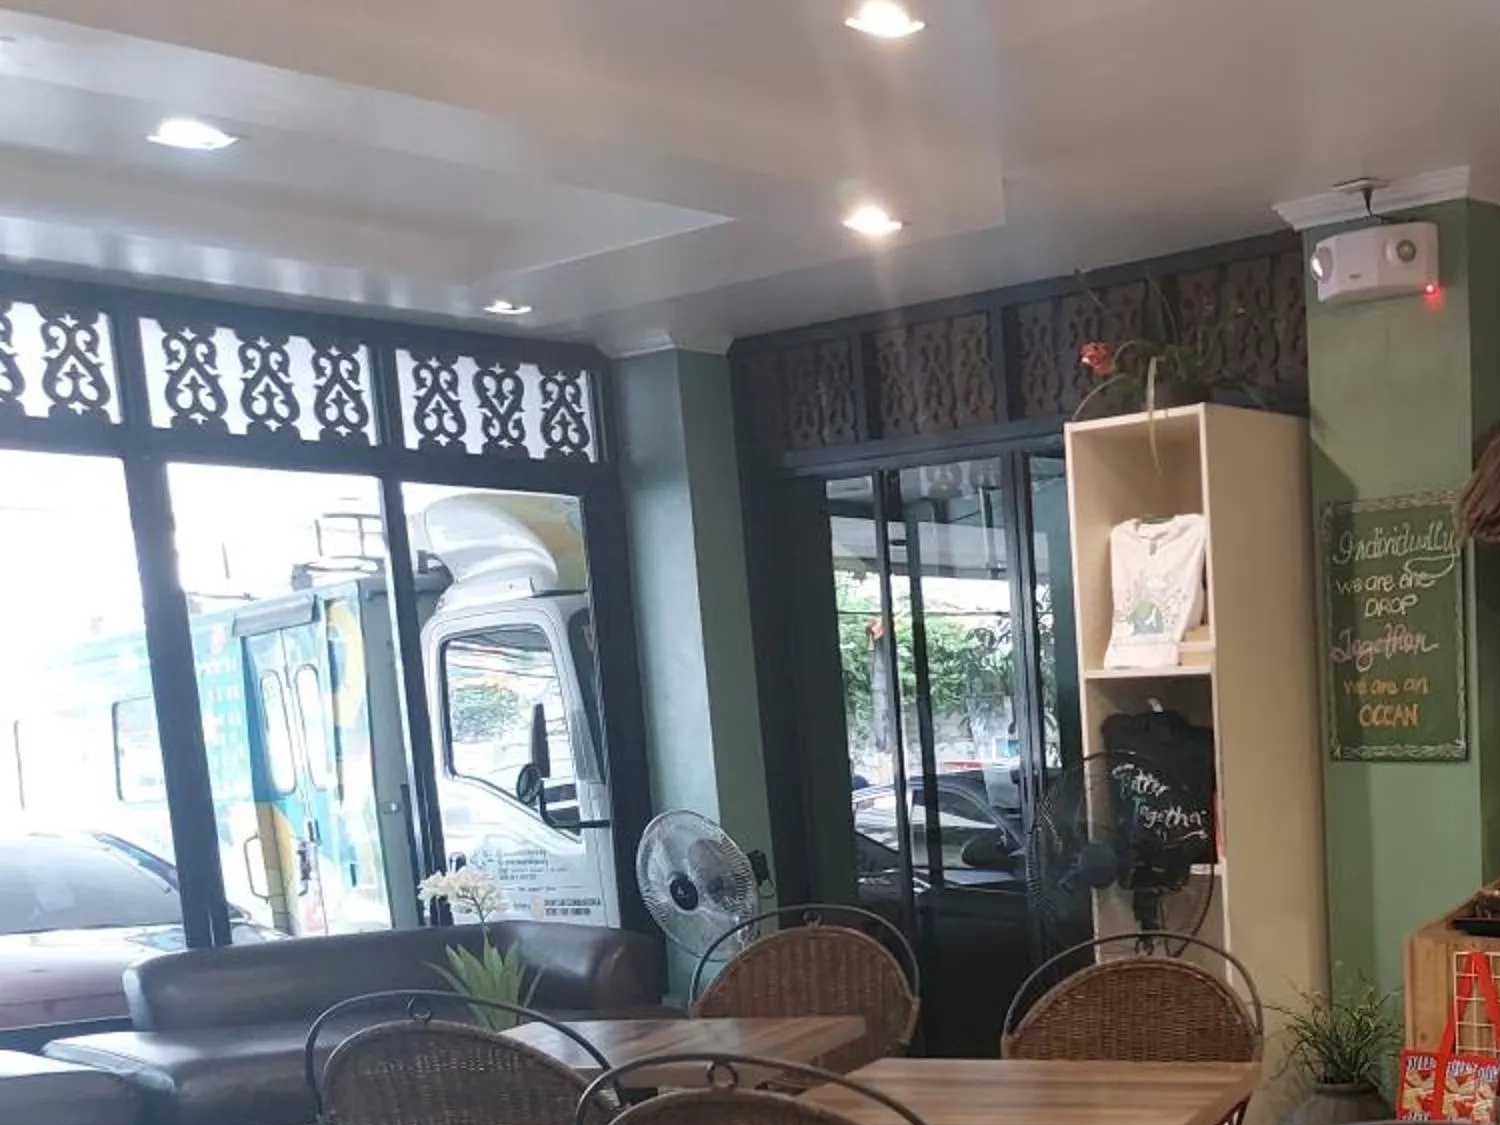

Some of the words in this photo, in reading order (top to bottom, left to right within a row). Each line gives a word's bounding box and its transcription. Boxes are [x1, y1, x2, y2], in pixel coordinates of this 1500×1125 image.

[1336, 578, 1362, 594] we
[1365, 574, 1395, 592] are
[1365, 594, 1418, 617] DROP
[1344, 677, 1366, 695] we
[1371, 678, 1398, 695] are
[1404, 676, 1429, 696] an
[1359, 703, 1419, 728] OCEAN
